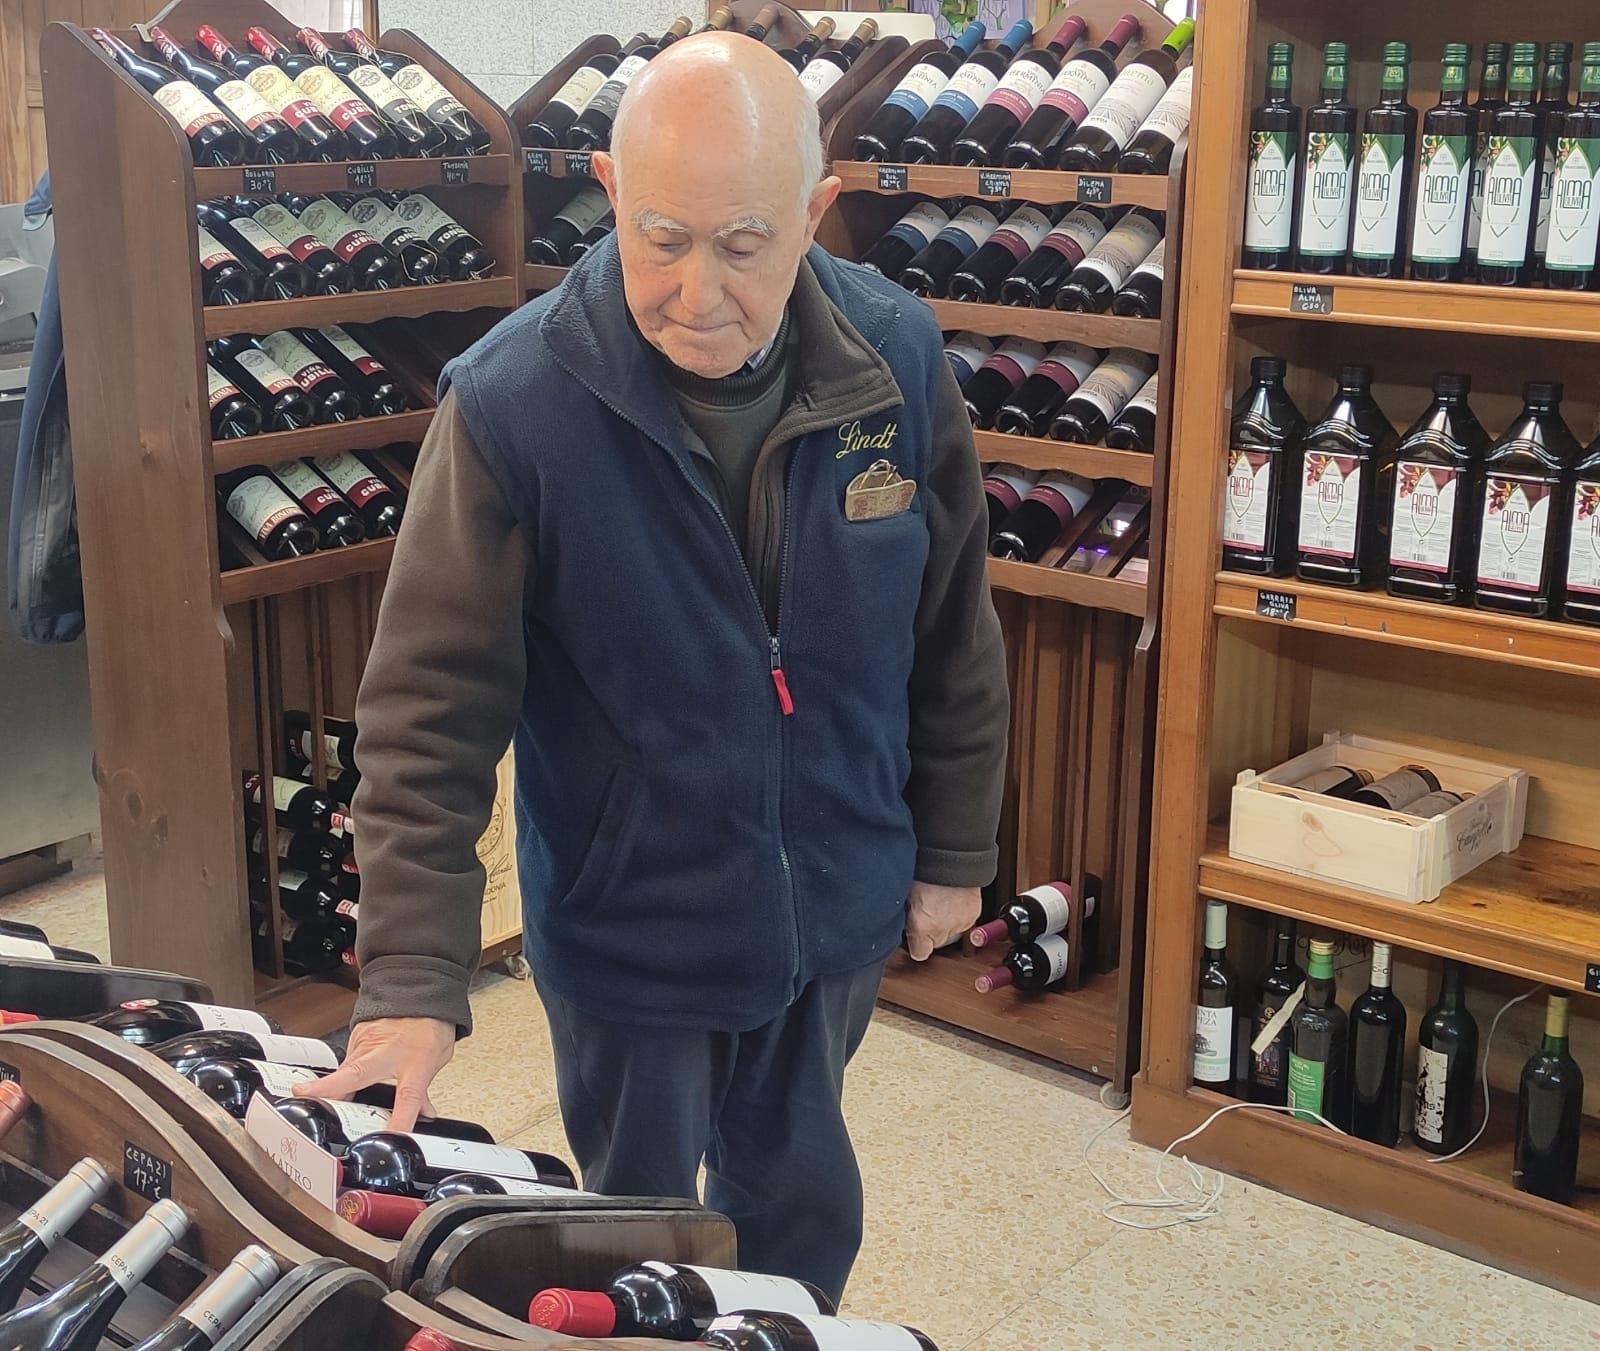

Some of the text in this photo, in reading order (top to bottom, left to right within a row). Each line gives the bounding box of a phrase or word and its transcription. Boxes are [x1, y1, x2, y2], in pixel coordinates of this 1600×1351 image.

[1253, 169, 1287, 197] ALMA
[1313, 172, 1347, 199] ALMA
[1360, 172, 1391, 201] ALMA
[1423, 174, 1459, 204] ALMA
[1487, 176, 1523, 207] ALMA
[1556, 178, 1592, 210] ALMA
[1298, 293, 1321, 304] ALMA
[300, 367, 336, 388] UBILL
[836, 421, 898, 459] Lindt
[1411, 492, 1438, 517] ALMA
[1501, 509, 1530, 534] ALMA
[126, 1146, 167, 1179] CEPA 21
[110, 1254, 136, 1281] CEPA 21
